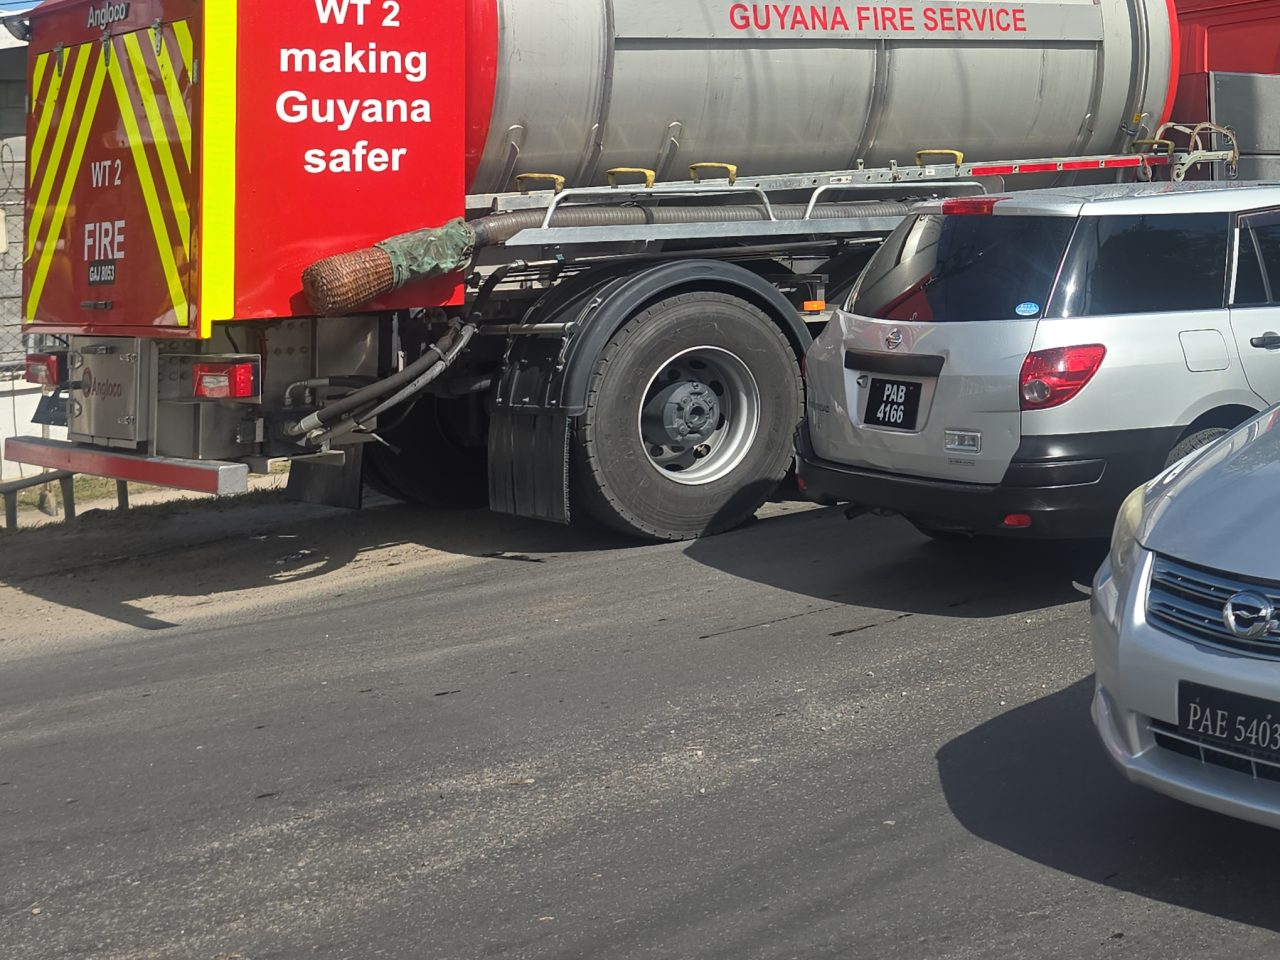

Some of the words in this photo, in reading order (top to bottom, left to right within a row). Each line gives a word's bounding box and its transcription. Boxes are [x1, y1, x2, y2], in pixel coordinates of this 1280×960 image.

[87, 2, 126, 30] Angloco
[382, 0, 401, 27] 2
[729, 3, 849, 31] GUYANA
[857, 6, 915, 31] FIRE
[923, 8, 1027, 33] SERVICE
[280, 43, 428, 82] making
[275, 90, 431, 131] Guyana
[304, 141, 406, 173] safer
[91, 160, 111, 188] WT
[114, 158, 122, 186] 2
[84, 220, 126, 261] FIRE
[89, 266, 100, 282] GAJ
[101, 265, 115, 281] 8053
[92, 377, 122, 402] Angloco
[883, 383, 906, 403] PAB
[876, 403, 904, 424] 4166
[1186, 703, 1229, 738] PAE
